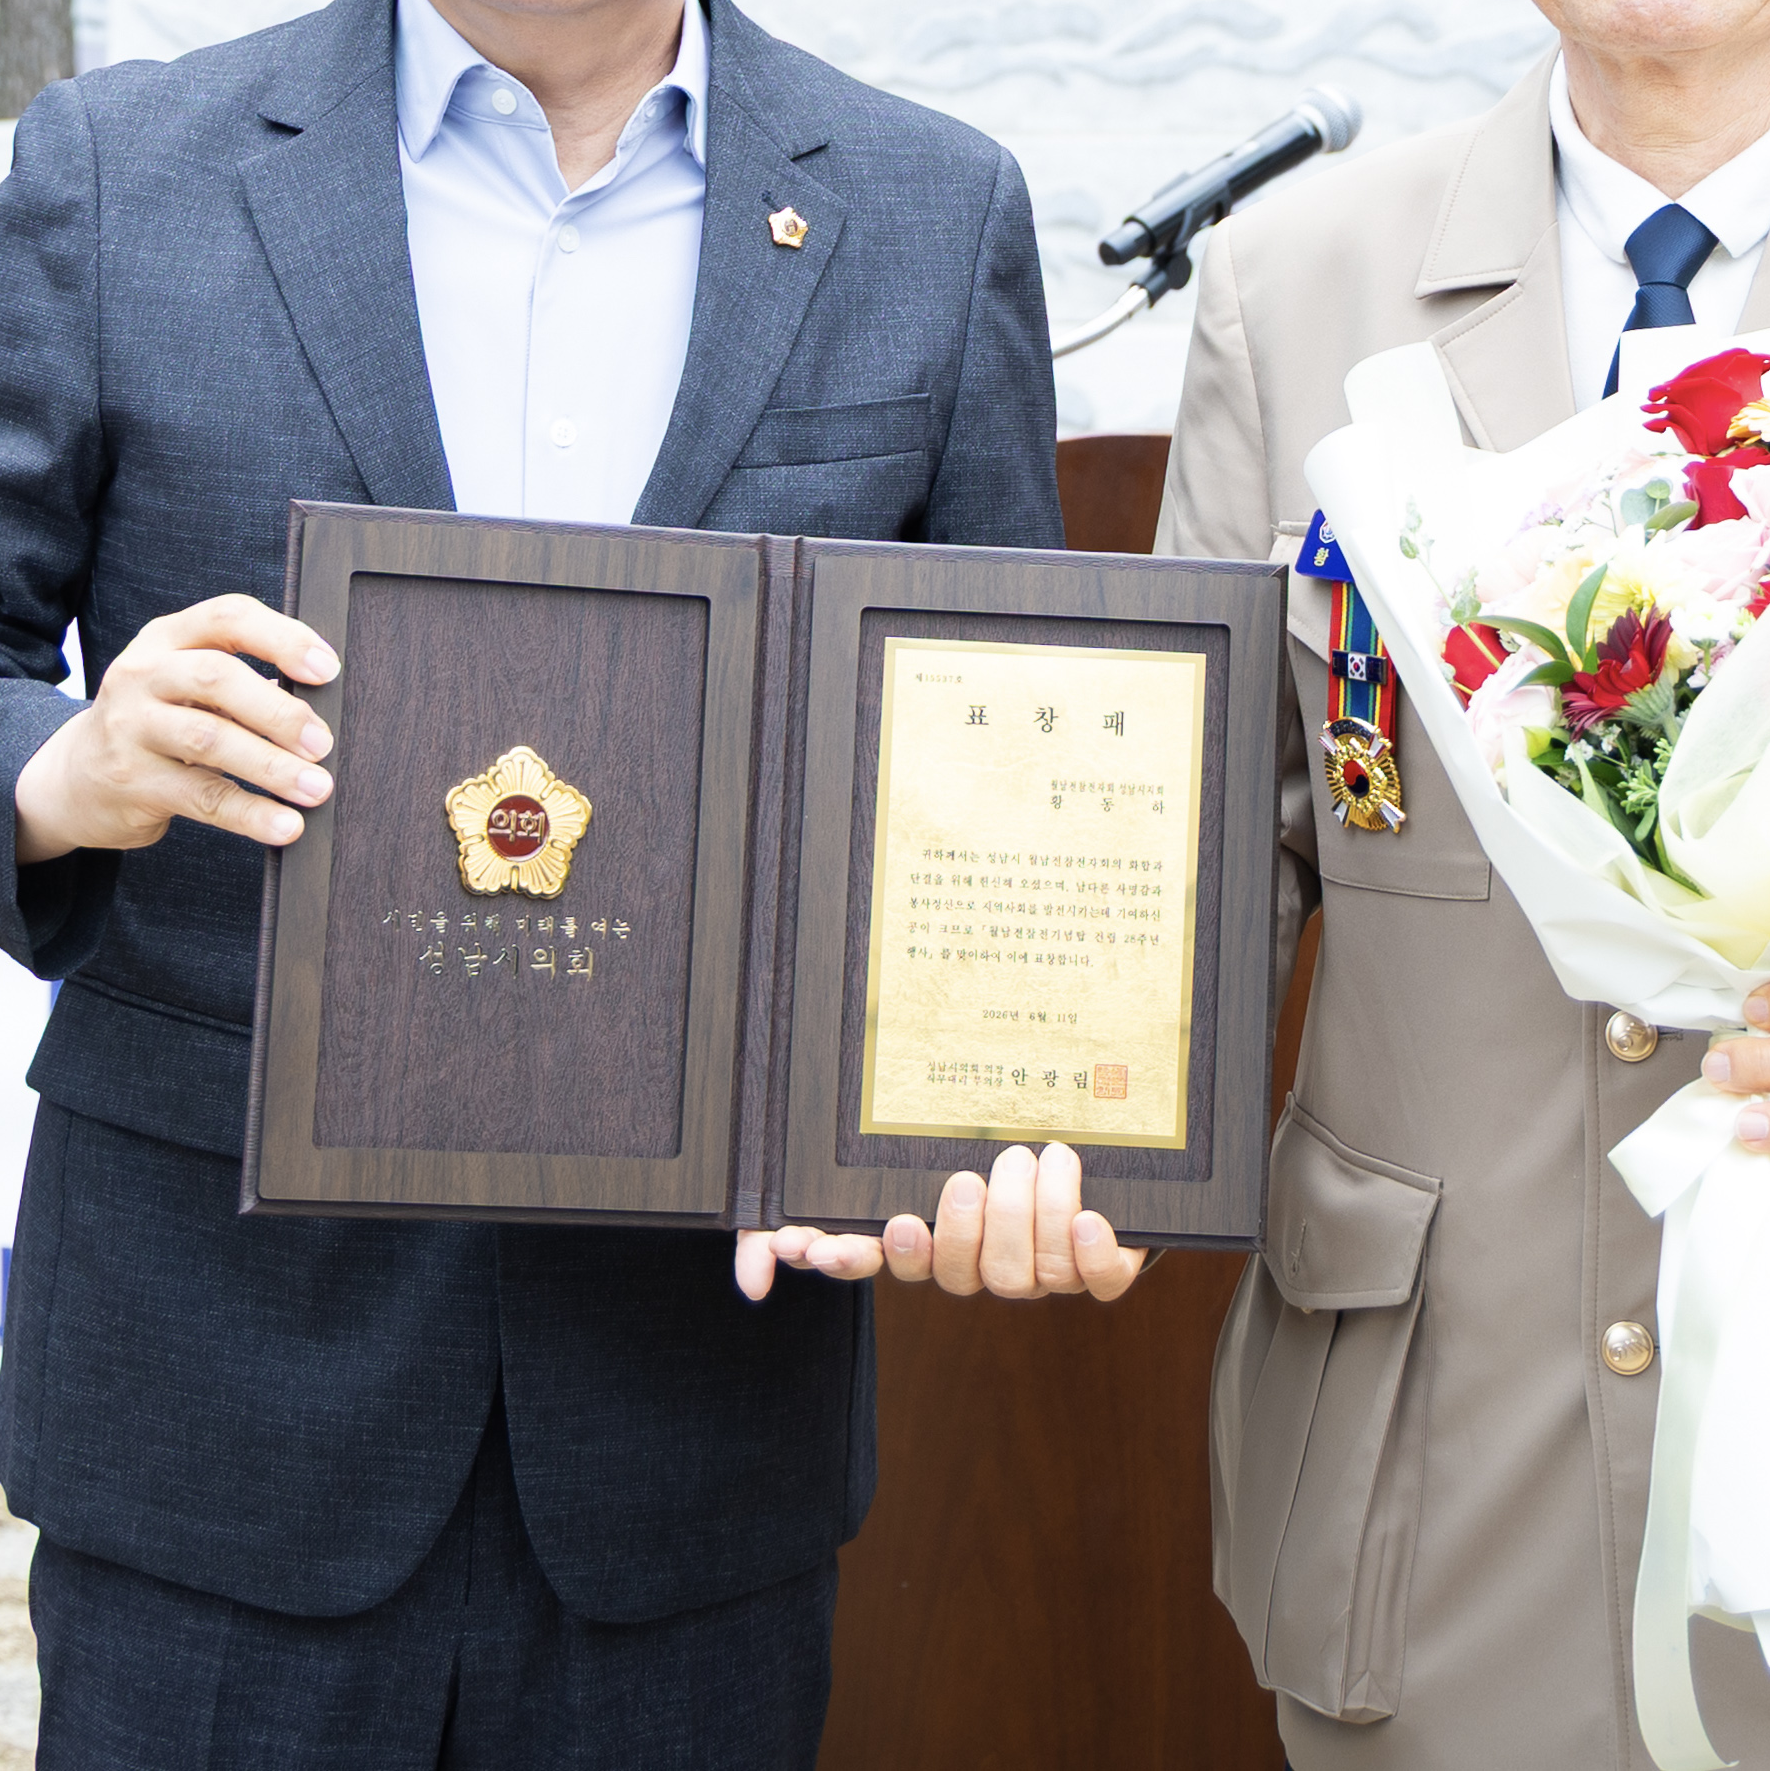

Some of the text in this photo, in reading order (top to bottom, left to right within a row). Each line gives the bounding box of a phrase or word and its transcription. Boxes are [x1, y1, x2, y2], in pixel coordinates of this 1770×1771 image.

[965, 705, 1125, 737] 표 창 패
[488, 808, 546, 843] 의회
[989, 852, 1020, 865] 성남시
[951, 874, 972, 886] 위해
[910, 897, 976, 911] 봉사정신으로
[1117, 908, 1161, 921] 기여하신
[382, 909, 449, 933] 시민을
[515, 914, 578, 938] 미래를
[418, 941, 594, 981] 성남시의회
[1007, 951, 1028, 964] 이에
